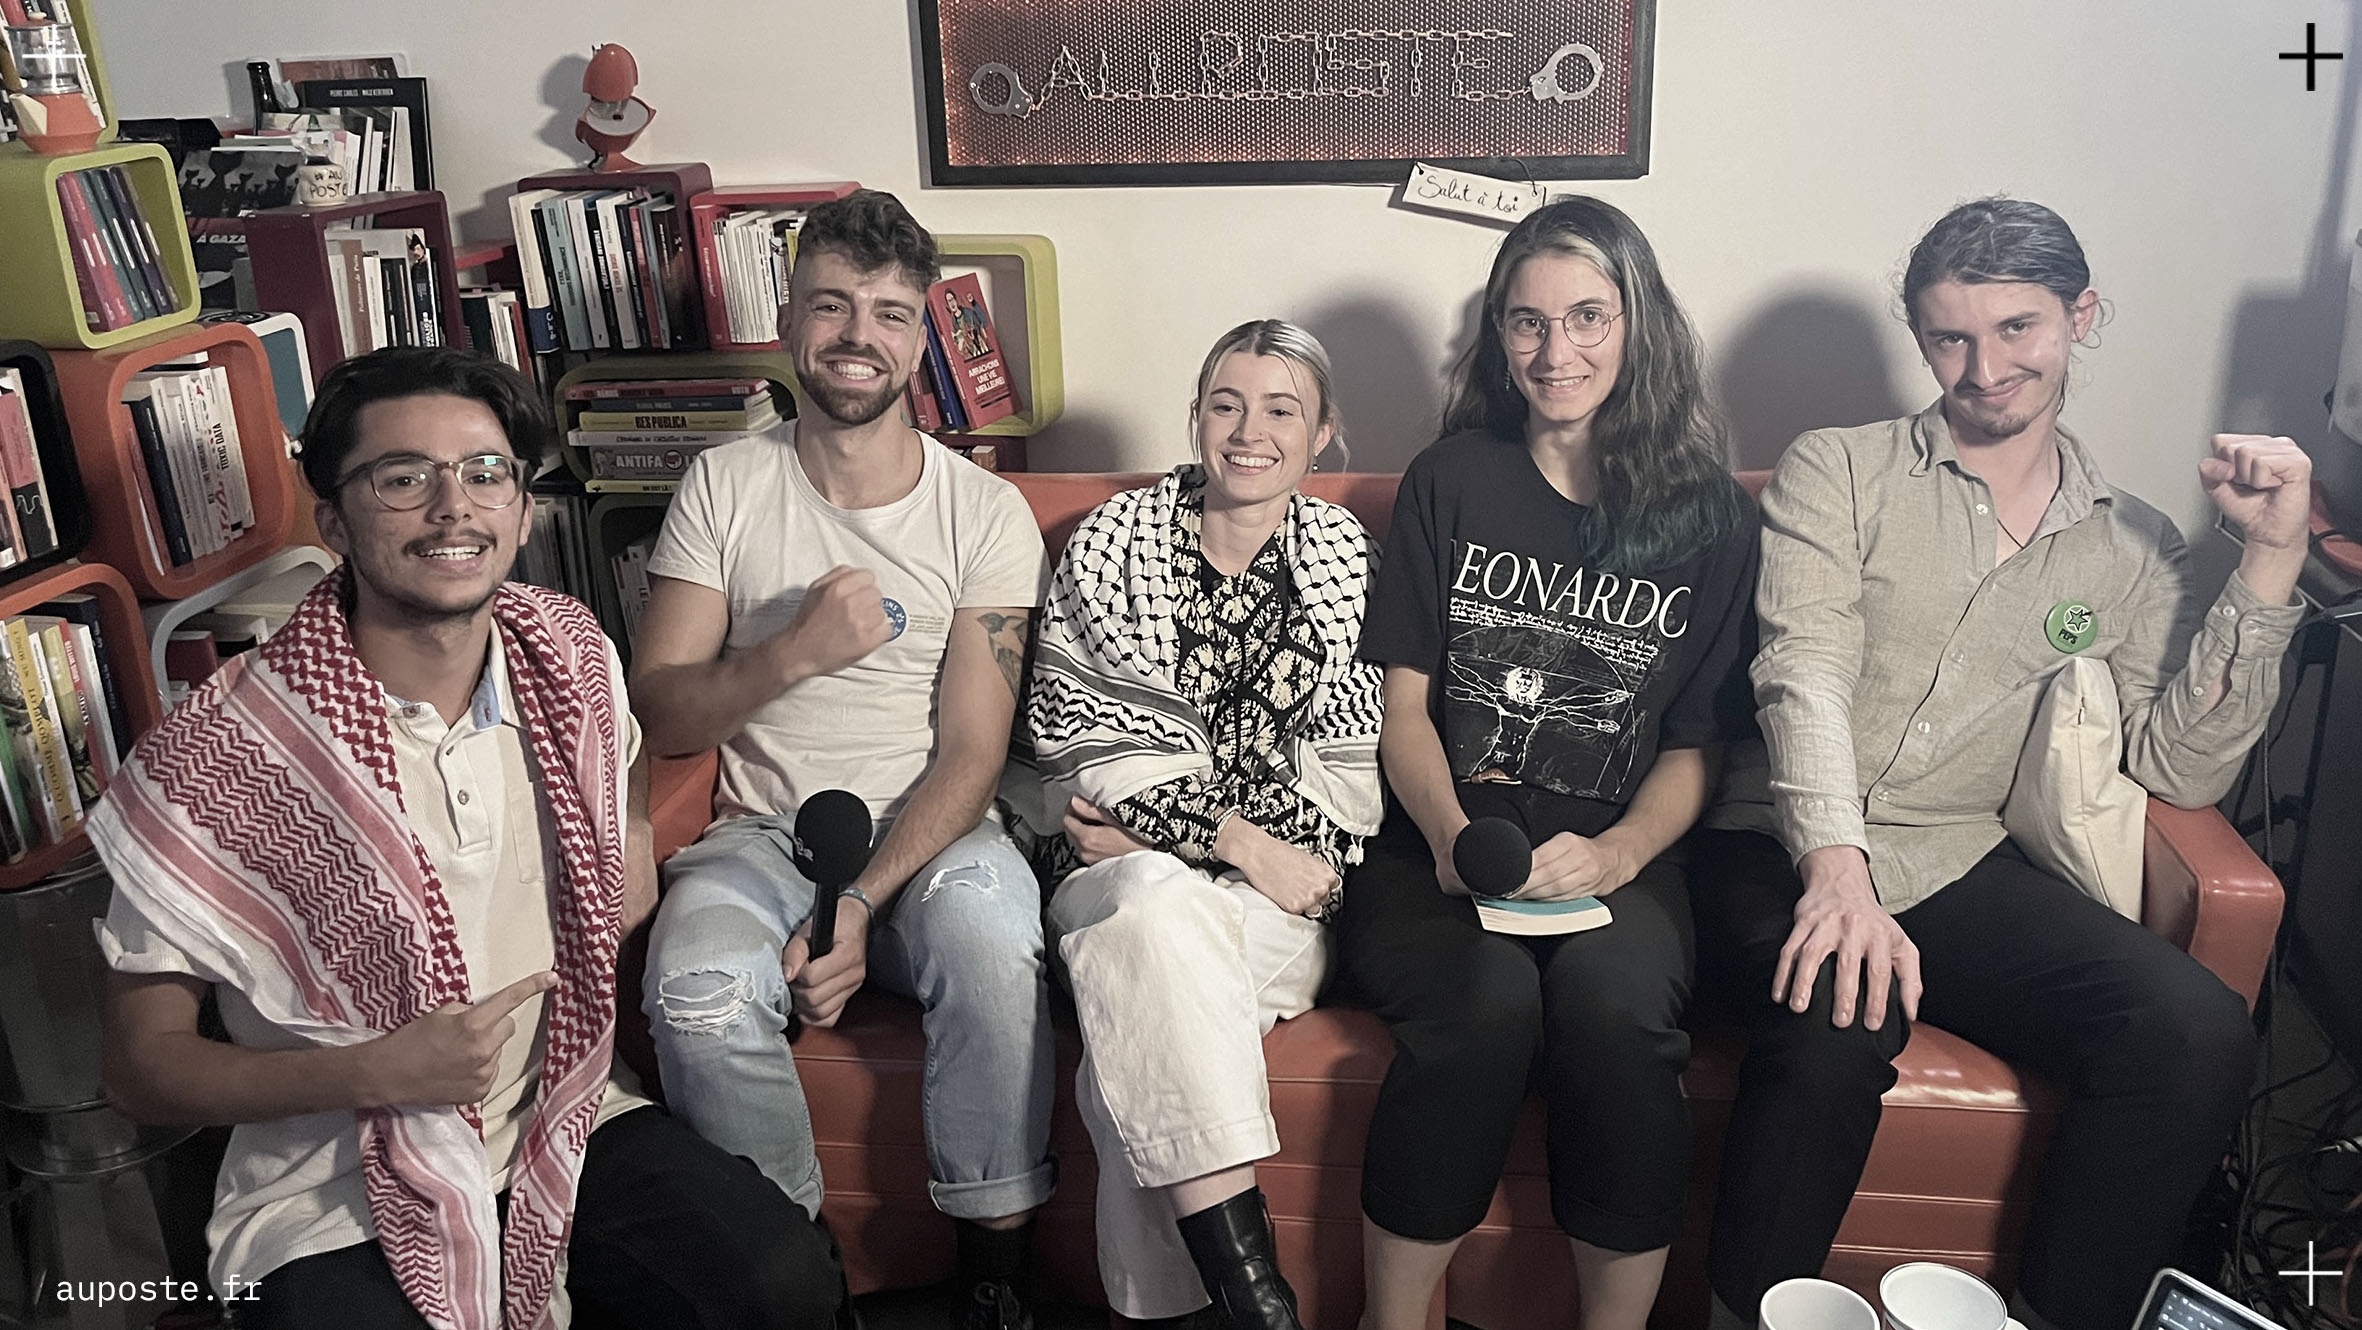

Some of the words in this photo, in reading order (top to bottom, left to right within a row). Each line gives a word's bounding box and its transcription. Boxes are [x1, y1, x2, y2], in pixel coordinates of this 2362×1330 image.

[1418, 175, 1472, 199] Salut
[1477, 191, 1488, 207] à
[1492, 190, 1518, 213] toi
[209, 234, 247, 244] GAZA
[212, 422, 225, 445] DATA
[216, 445, 230, 471] TOXIC
[616, 454, 664, 468] ANTIFA
